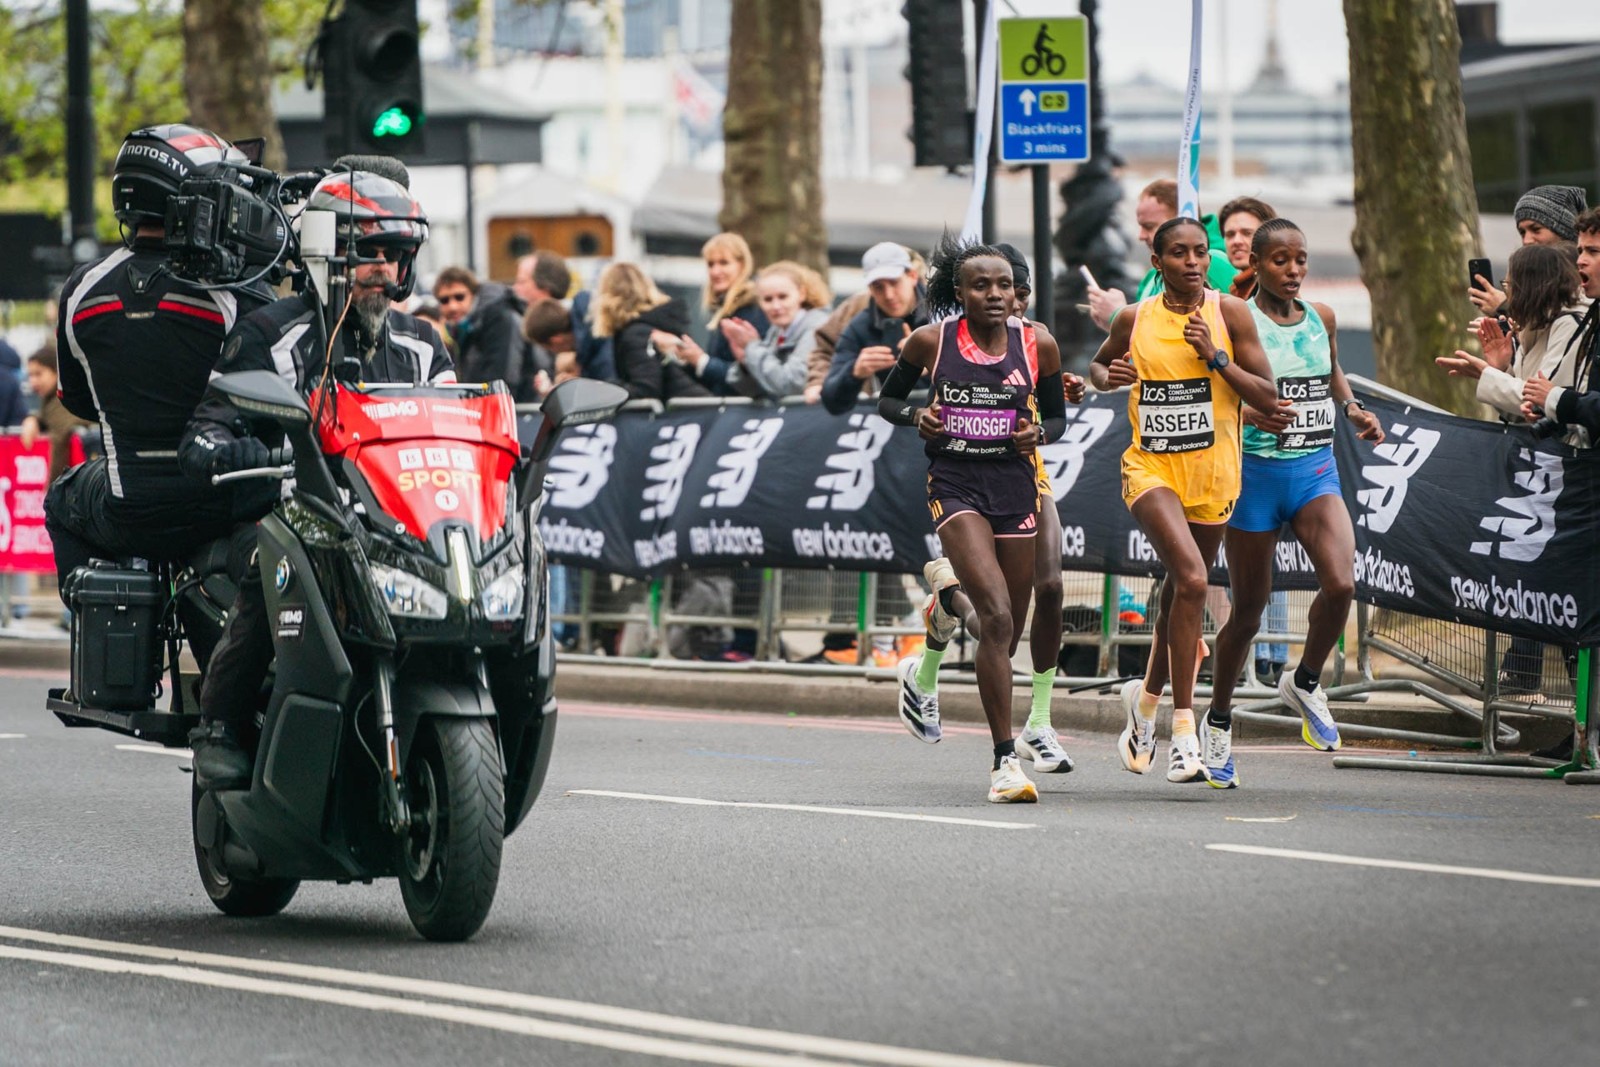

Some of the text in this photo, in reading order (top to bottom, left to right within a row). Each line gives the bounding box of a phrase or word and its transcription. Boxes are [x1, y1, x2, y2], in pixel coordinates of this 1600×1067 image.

[1042, 95, 1066, 108] C3
[1183, 68, 1199, 141] INFORMATION
[1007, 122, 1083, 135] Blackfriars
[1023, 141, 1067, 154] 3 mins
[943, 384, 970, 404] tcs
[972, 392, 1012, 400] CONSULTANCY
[1142, 382, 1166, 402] tcs
[1168, 387, 1207, 396] CONSULTANCY
[1168, 394, 1193, 402] SERVICES
[1282, 381, 1308, 399] tcs
[374, 400, 419, 419] EMG
[944, 414, 1011, 437] JEPKOSGEI
[1144, 411, 1209, 433] ASSEFA
[1182, 441, 1209, 450] balance
[398, 470, 482, 493] SPORT
[793, 522, 894, 560] new balance
[1276, 541, 1298, 573] new
[1451, 575, 1578, 629] new balance
